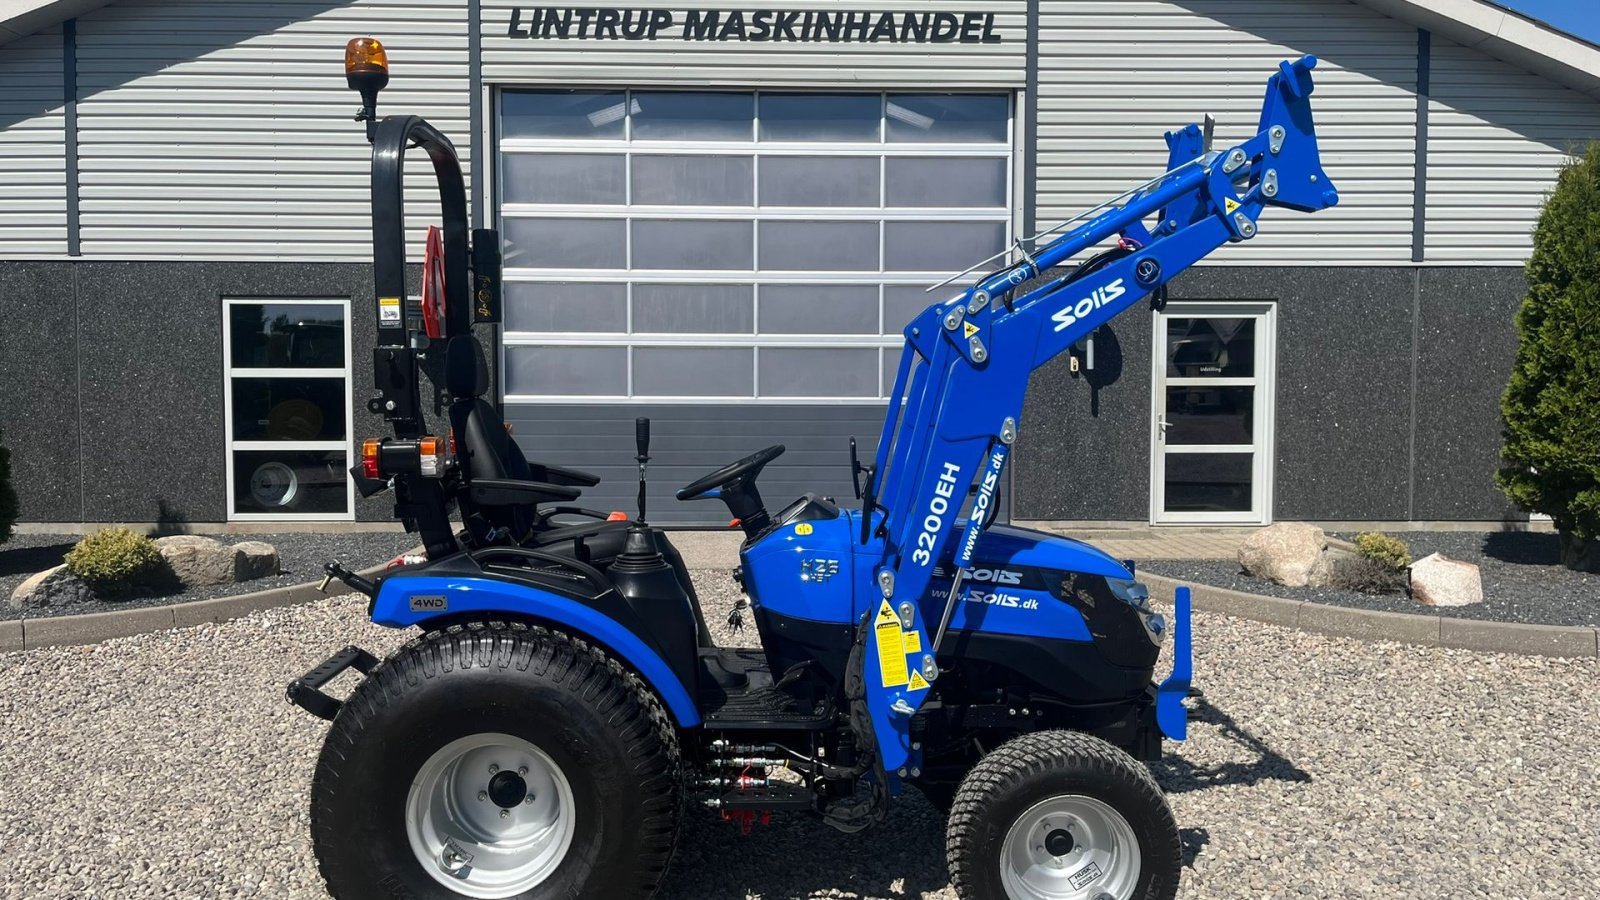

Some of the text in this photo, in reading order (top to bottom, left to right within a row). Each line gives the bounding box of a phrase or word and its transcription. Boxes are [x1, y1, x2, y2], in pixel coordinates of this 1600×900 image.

[508, 8, 1001, 43] LINTRUP MASKINHANDEL
[912, 461, 960, 567] 3200EH
[413, 599, 444, 608] 4WD
